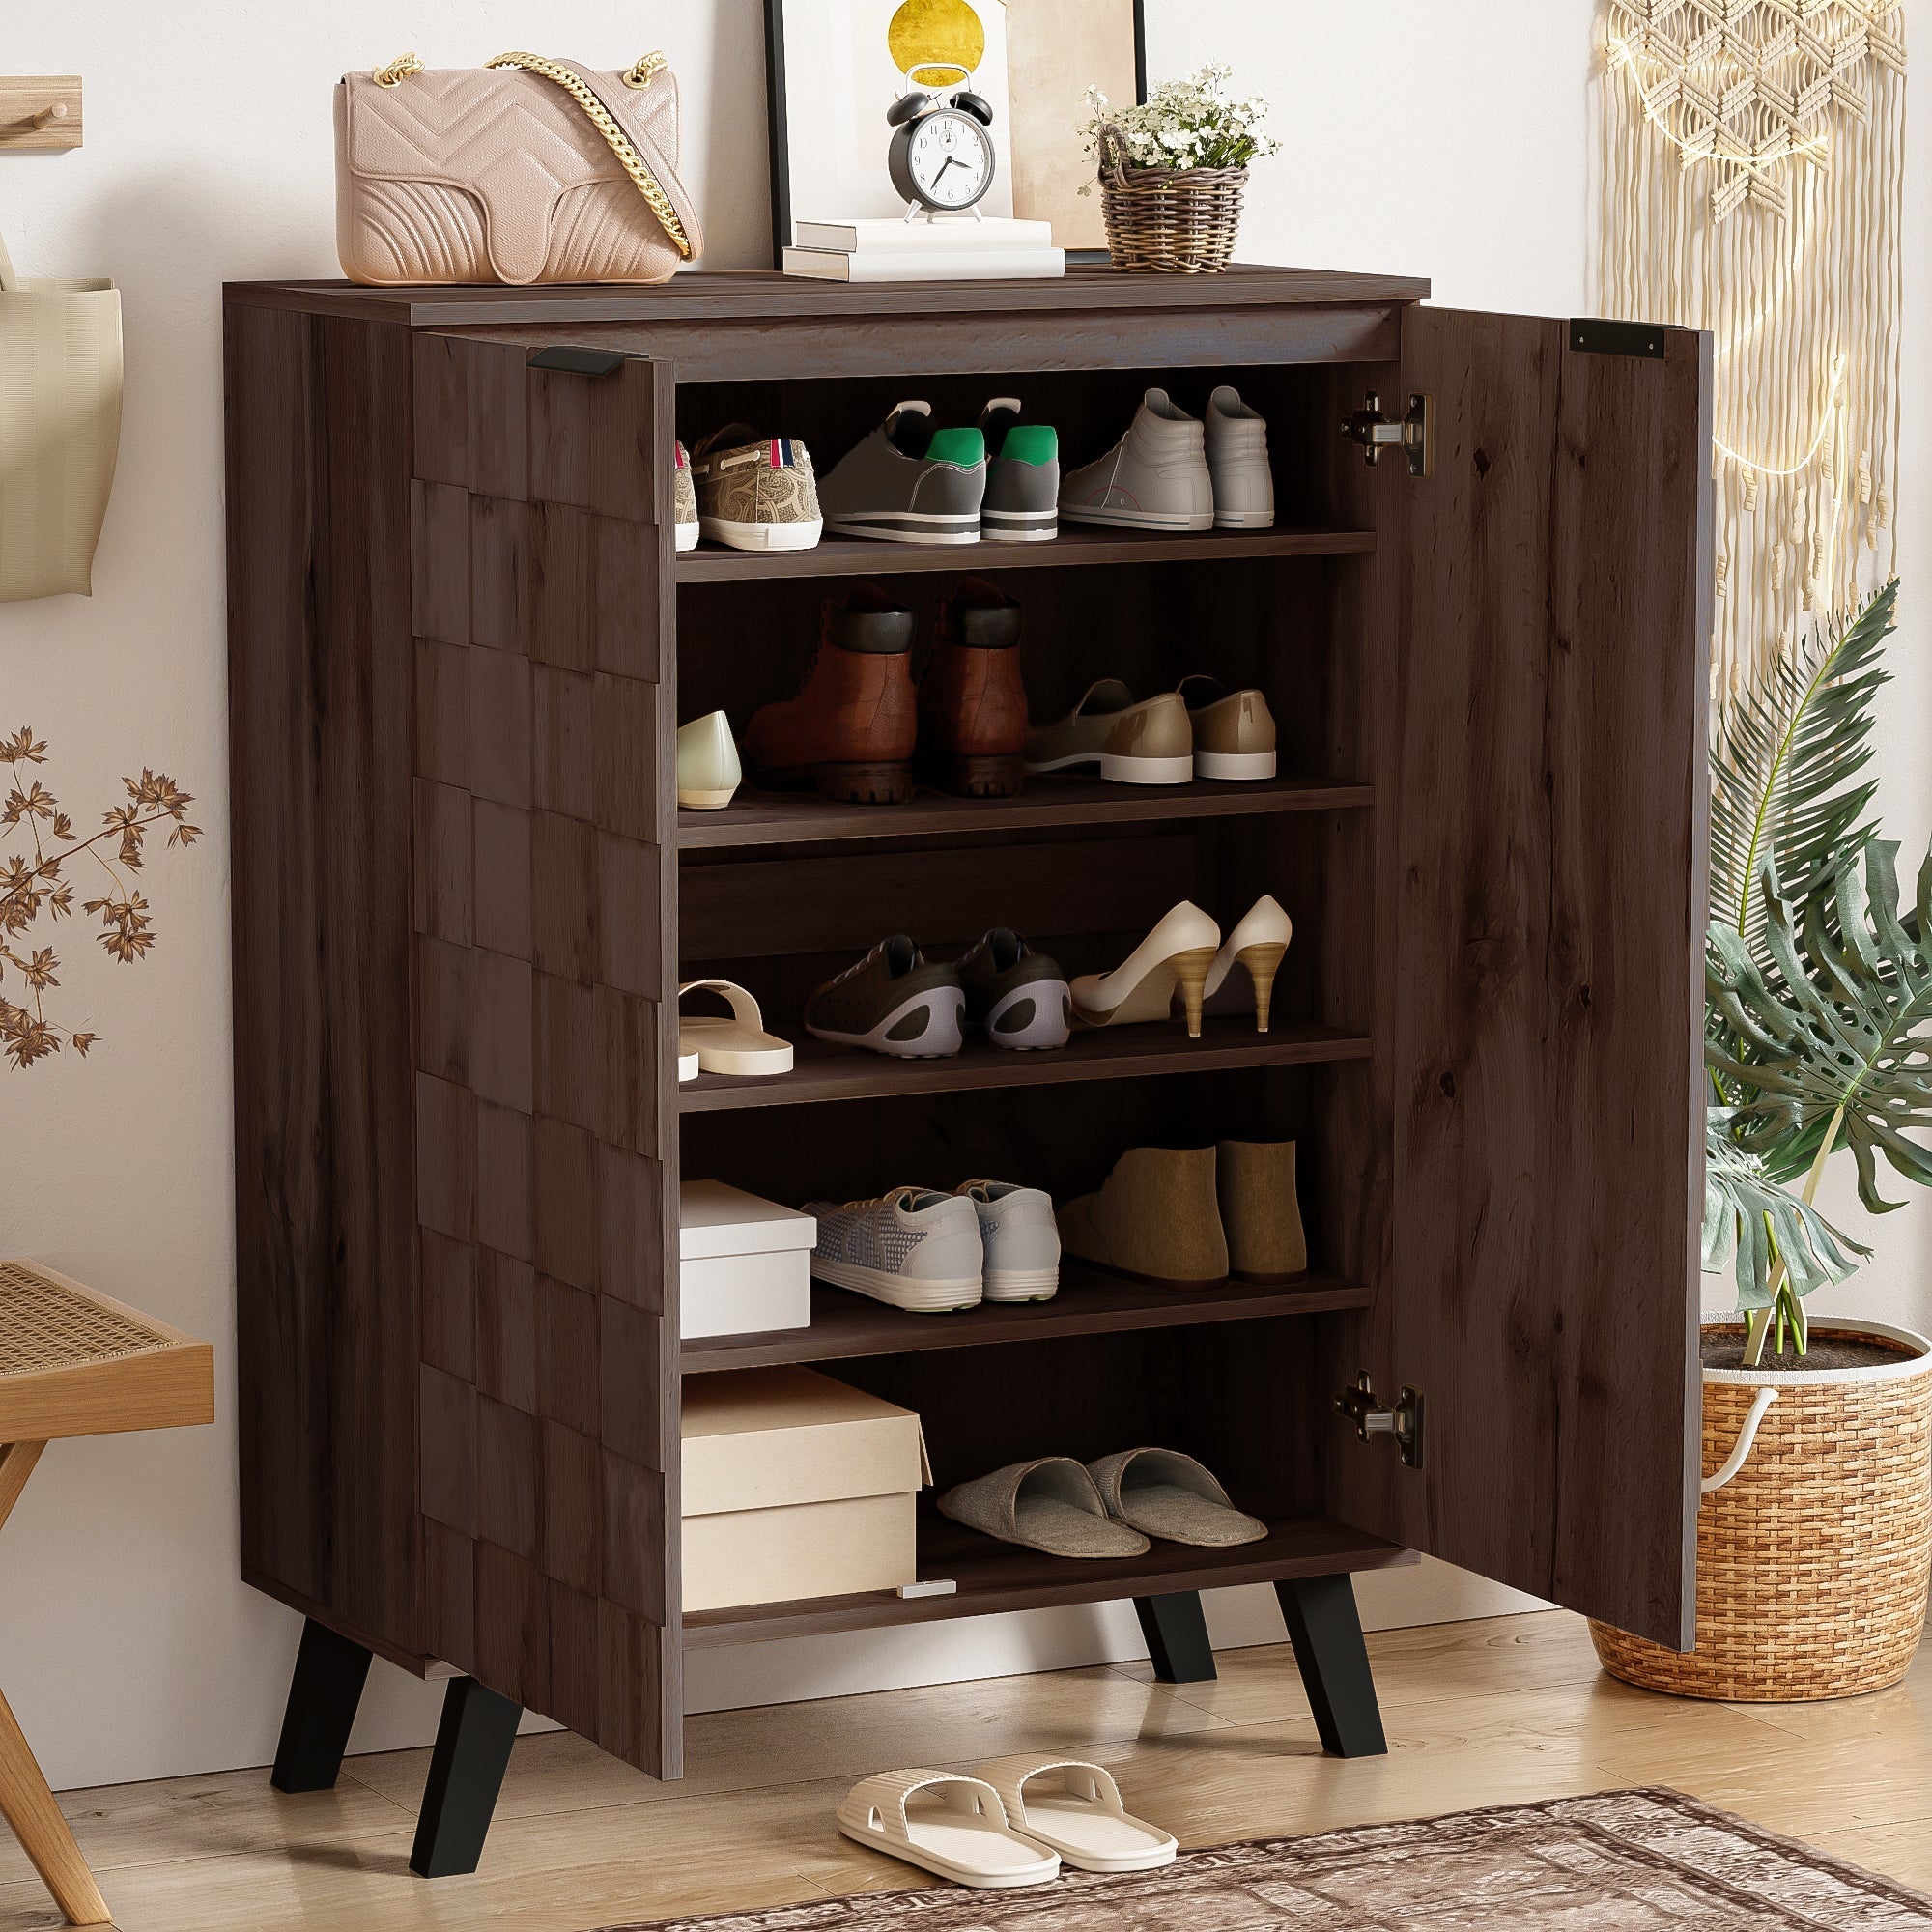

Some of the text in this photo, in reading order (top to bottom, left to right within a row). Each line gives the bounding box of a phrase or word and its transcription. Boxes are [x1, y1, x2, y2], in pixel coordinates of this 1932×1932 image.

[930, 125, 938, 135] 11
[944, 120, 952, 130] 12
[920, 137, 928, 149] 10
[973, 136, 979, 147] 2
[914, 156, 921, 166] 9
[978, 154, 984, 164] 3
[920, 172, 926, 184] 8
[947, 188, 953, 199] 6
